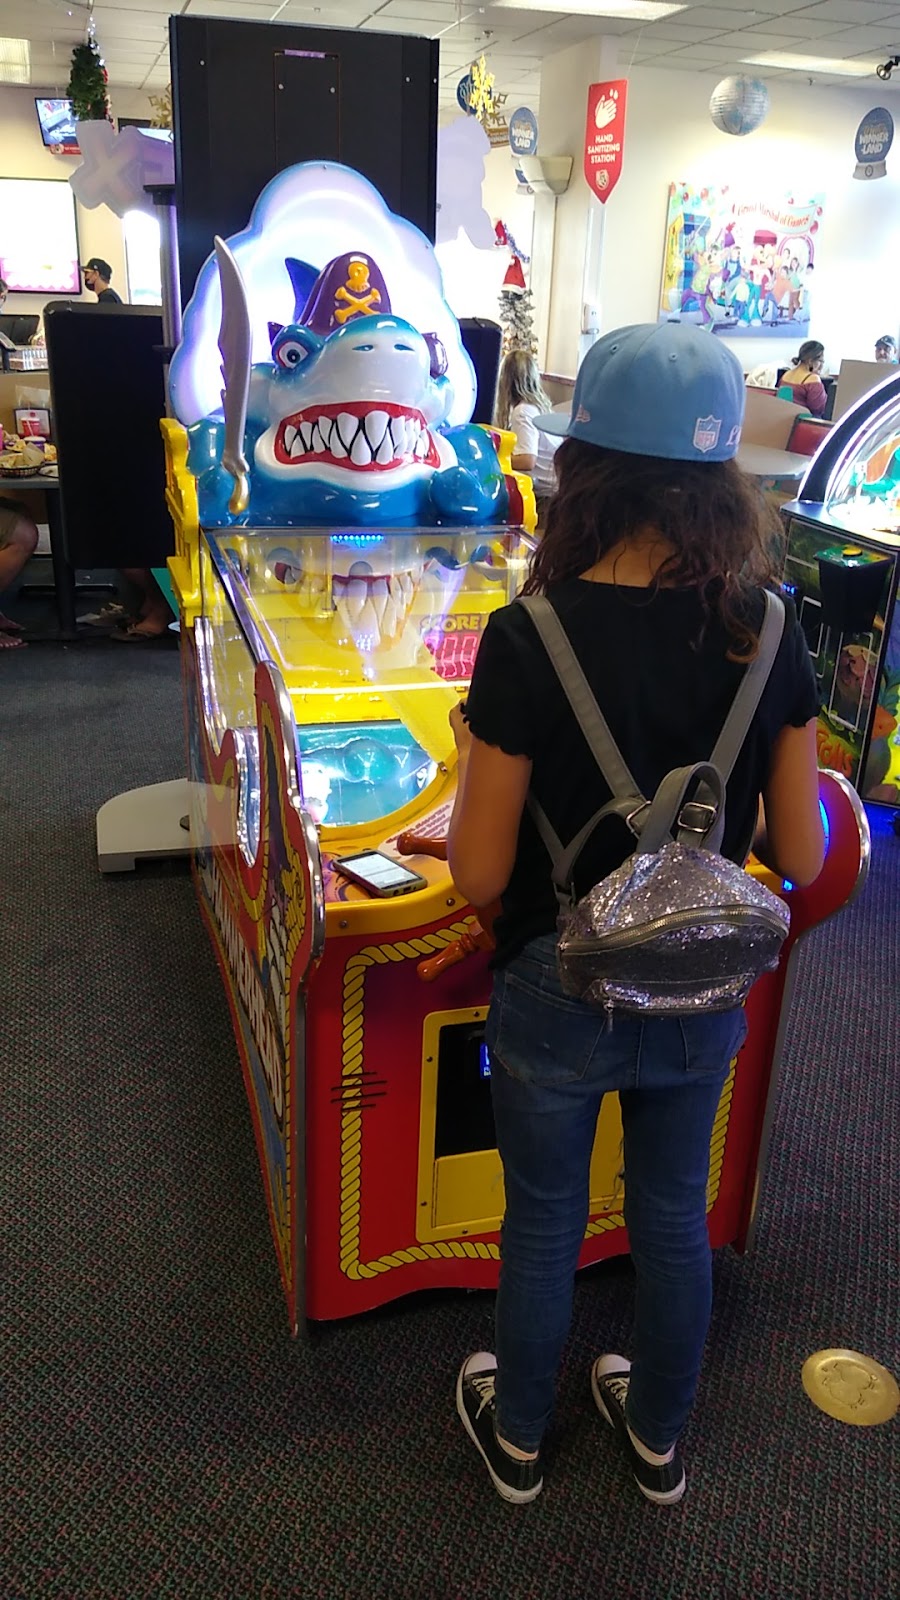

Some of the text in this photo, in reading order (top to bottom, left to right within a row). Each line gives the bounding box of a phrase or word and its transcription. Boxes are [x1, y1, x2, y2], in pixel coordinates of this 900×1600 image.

[595, 133, 614, 143] HAND
[587, 142, 621, 155] SANITIZING
[590, 153, 616, 164] STATION
